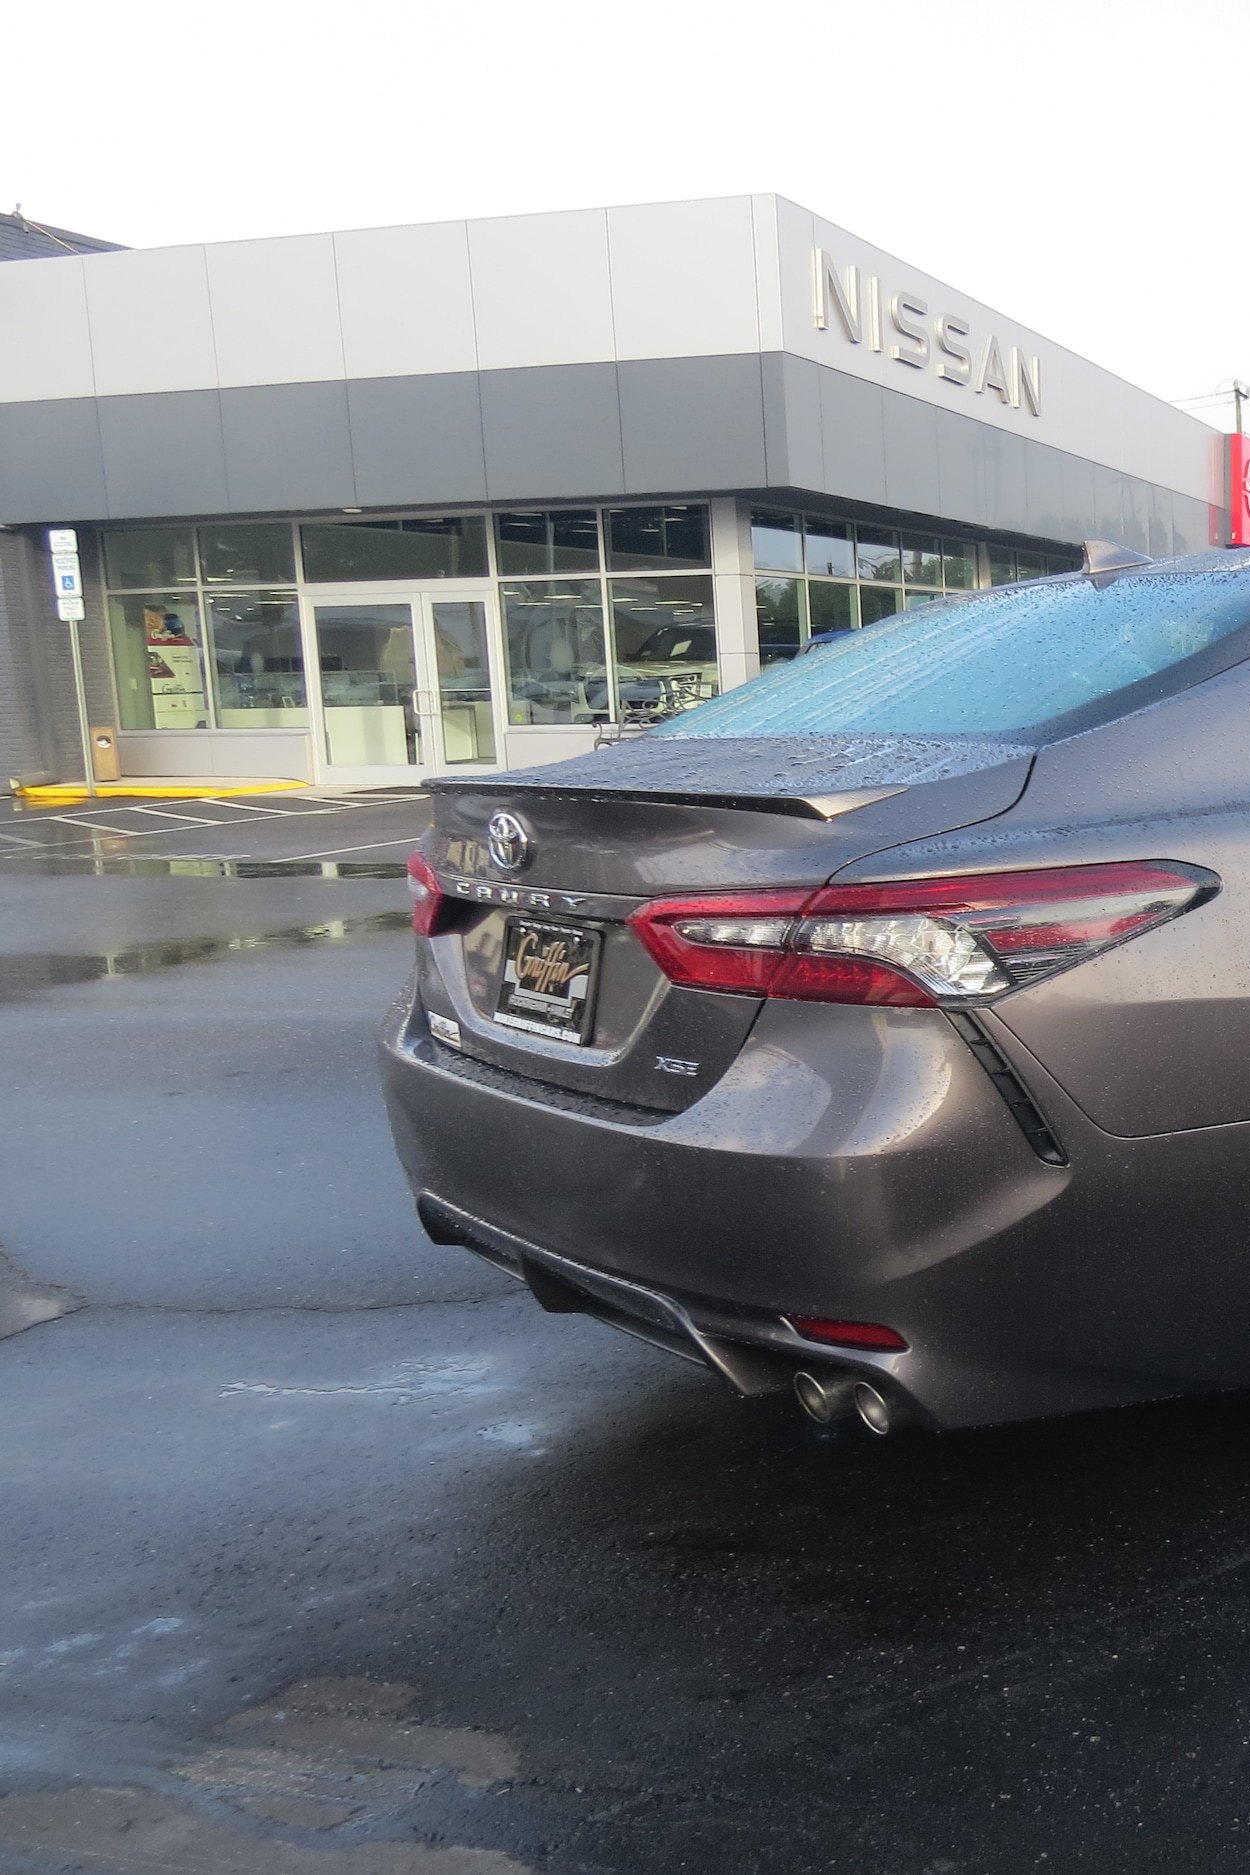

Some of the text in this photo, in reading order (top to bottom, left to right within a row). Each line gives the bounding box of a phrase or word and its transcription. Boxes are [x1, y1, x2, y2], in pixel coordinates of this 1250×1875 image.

[812, 247, 1042, 418] NISSAN
[456, 881, 586, 909] CAMRY
[516, 931, 590, 992] Griffin
[654, 1055, 700, 1077] XSE
